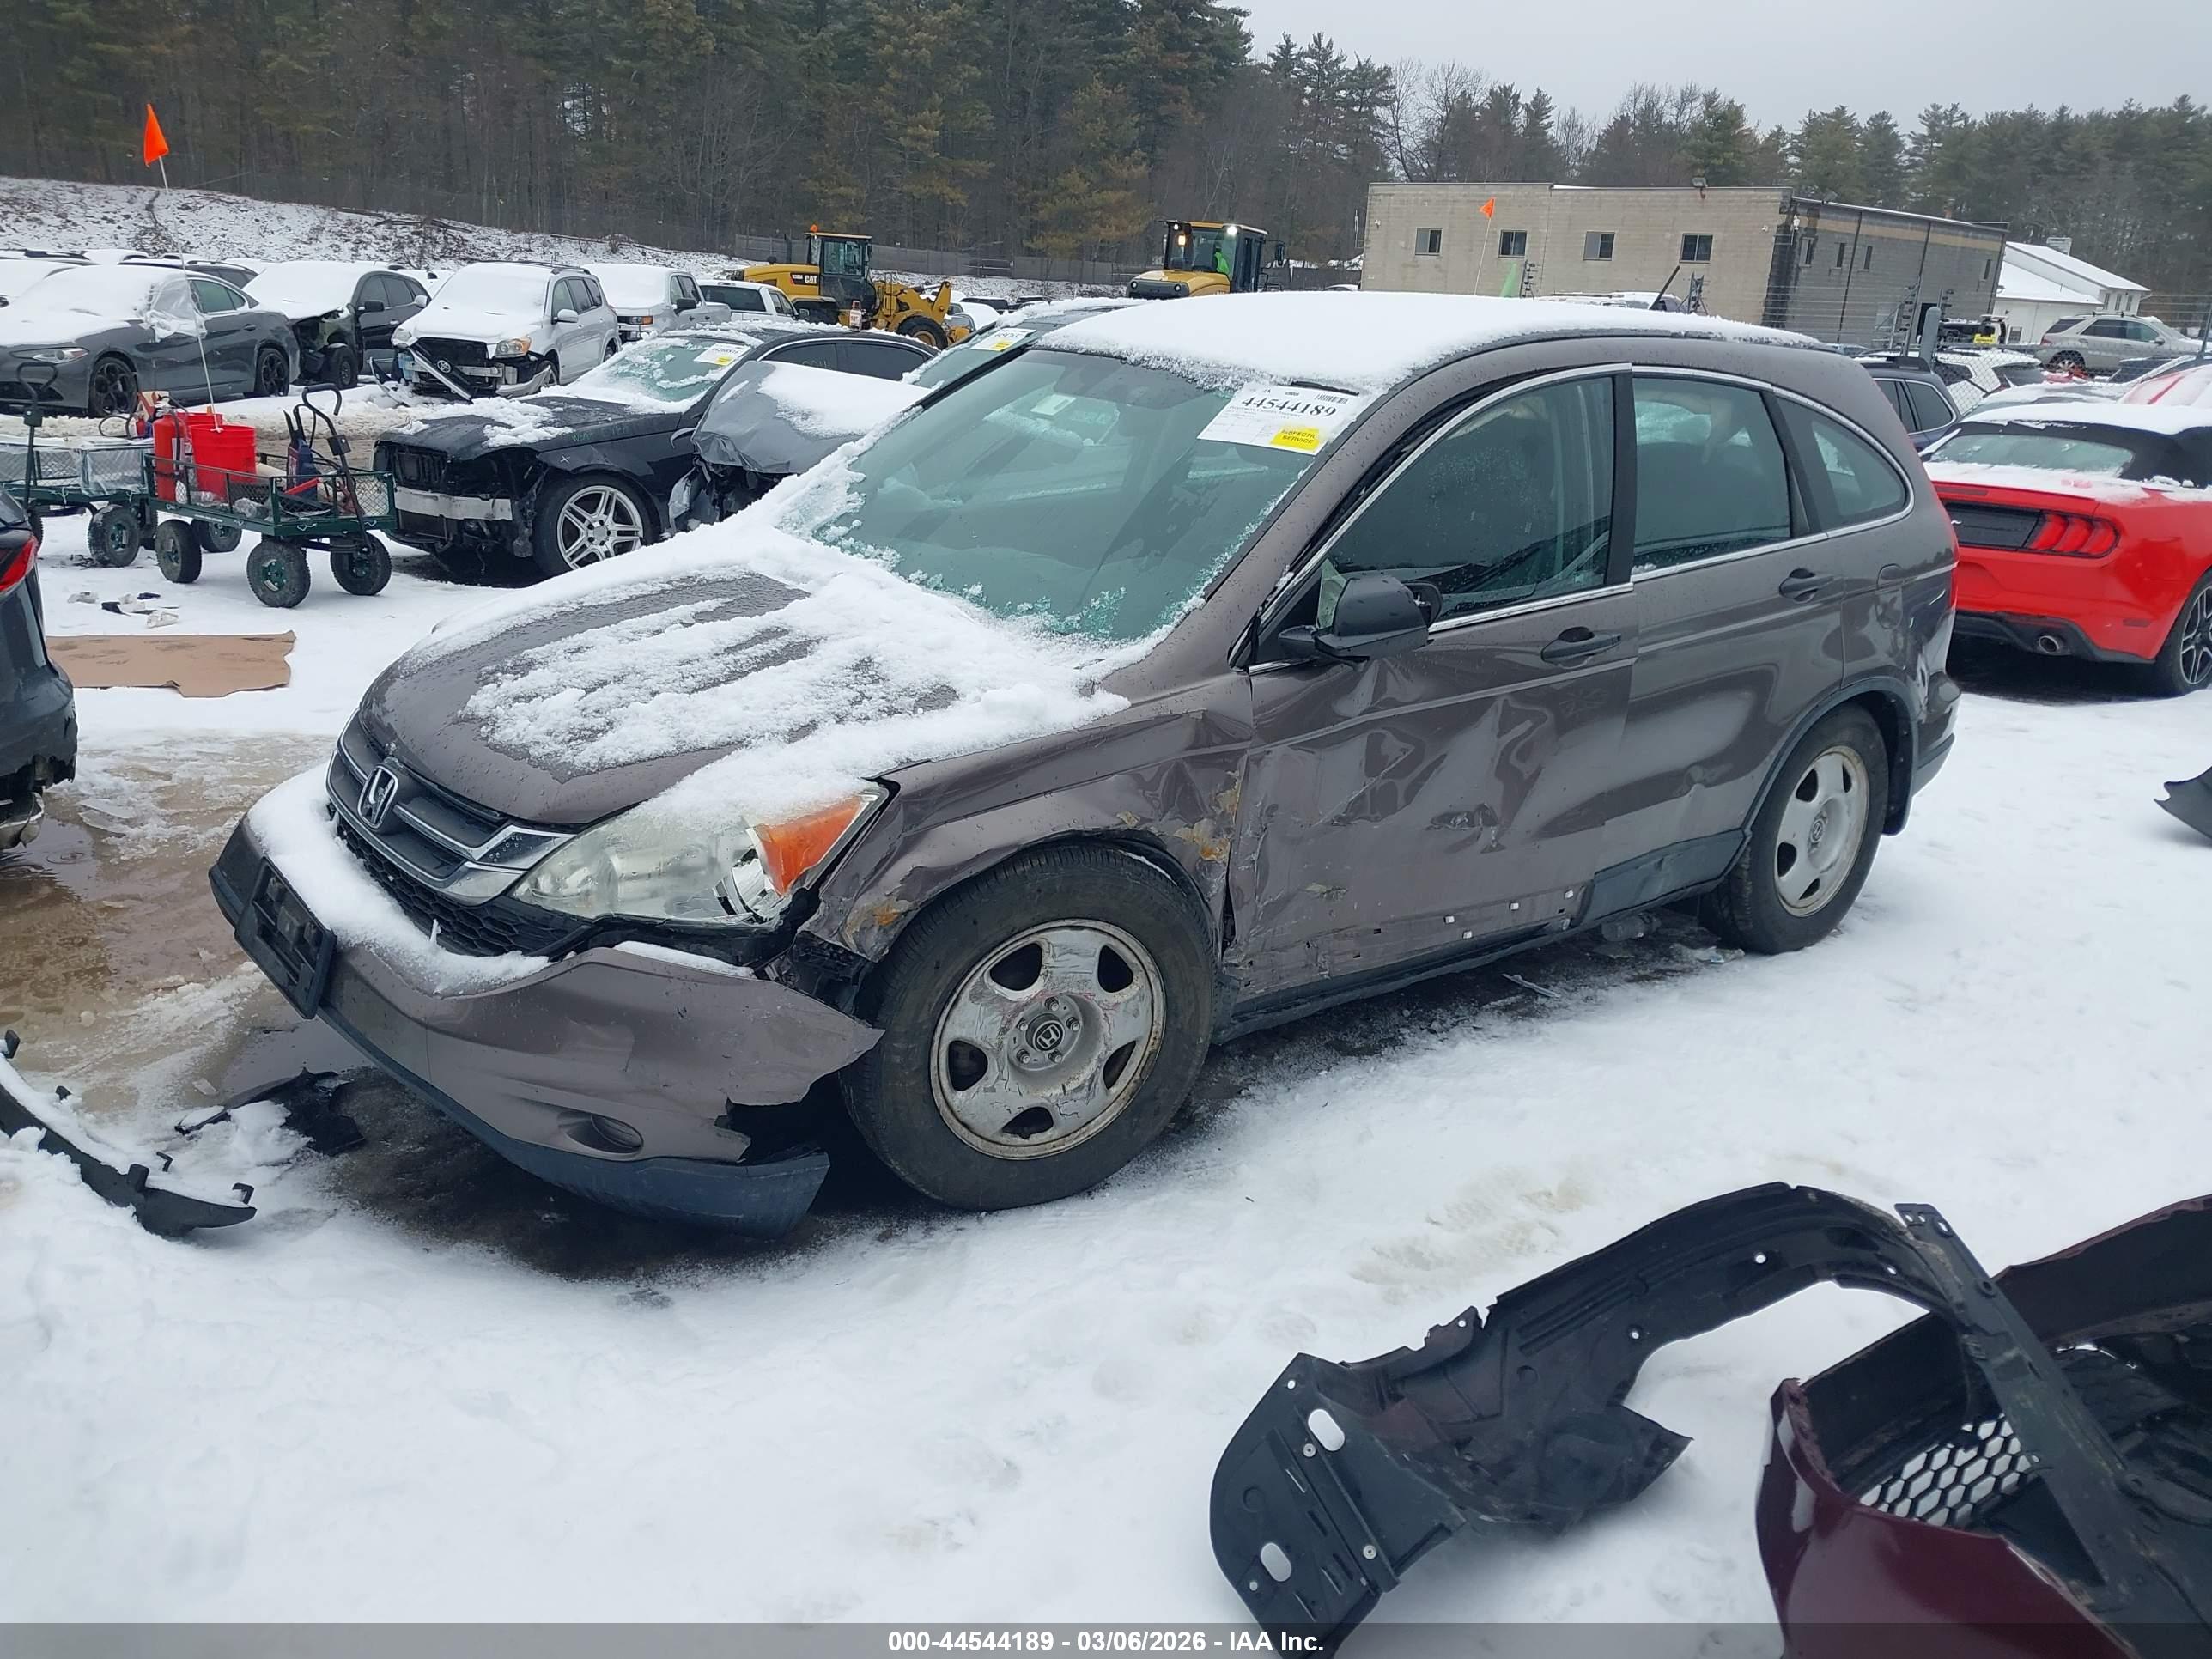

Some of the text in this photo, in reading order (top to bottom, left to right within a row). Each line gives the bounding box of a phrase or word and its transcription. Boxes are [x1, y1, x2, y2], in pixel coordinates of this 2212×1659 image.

[805, 275, 817, 284] CAT
[1242, 397, 1337, 417] 44544189
[1283, 434, 1314, 443] SERVICE
